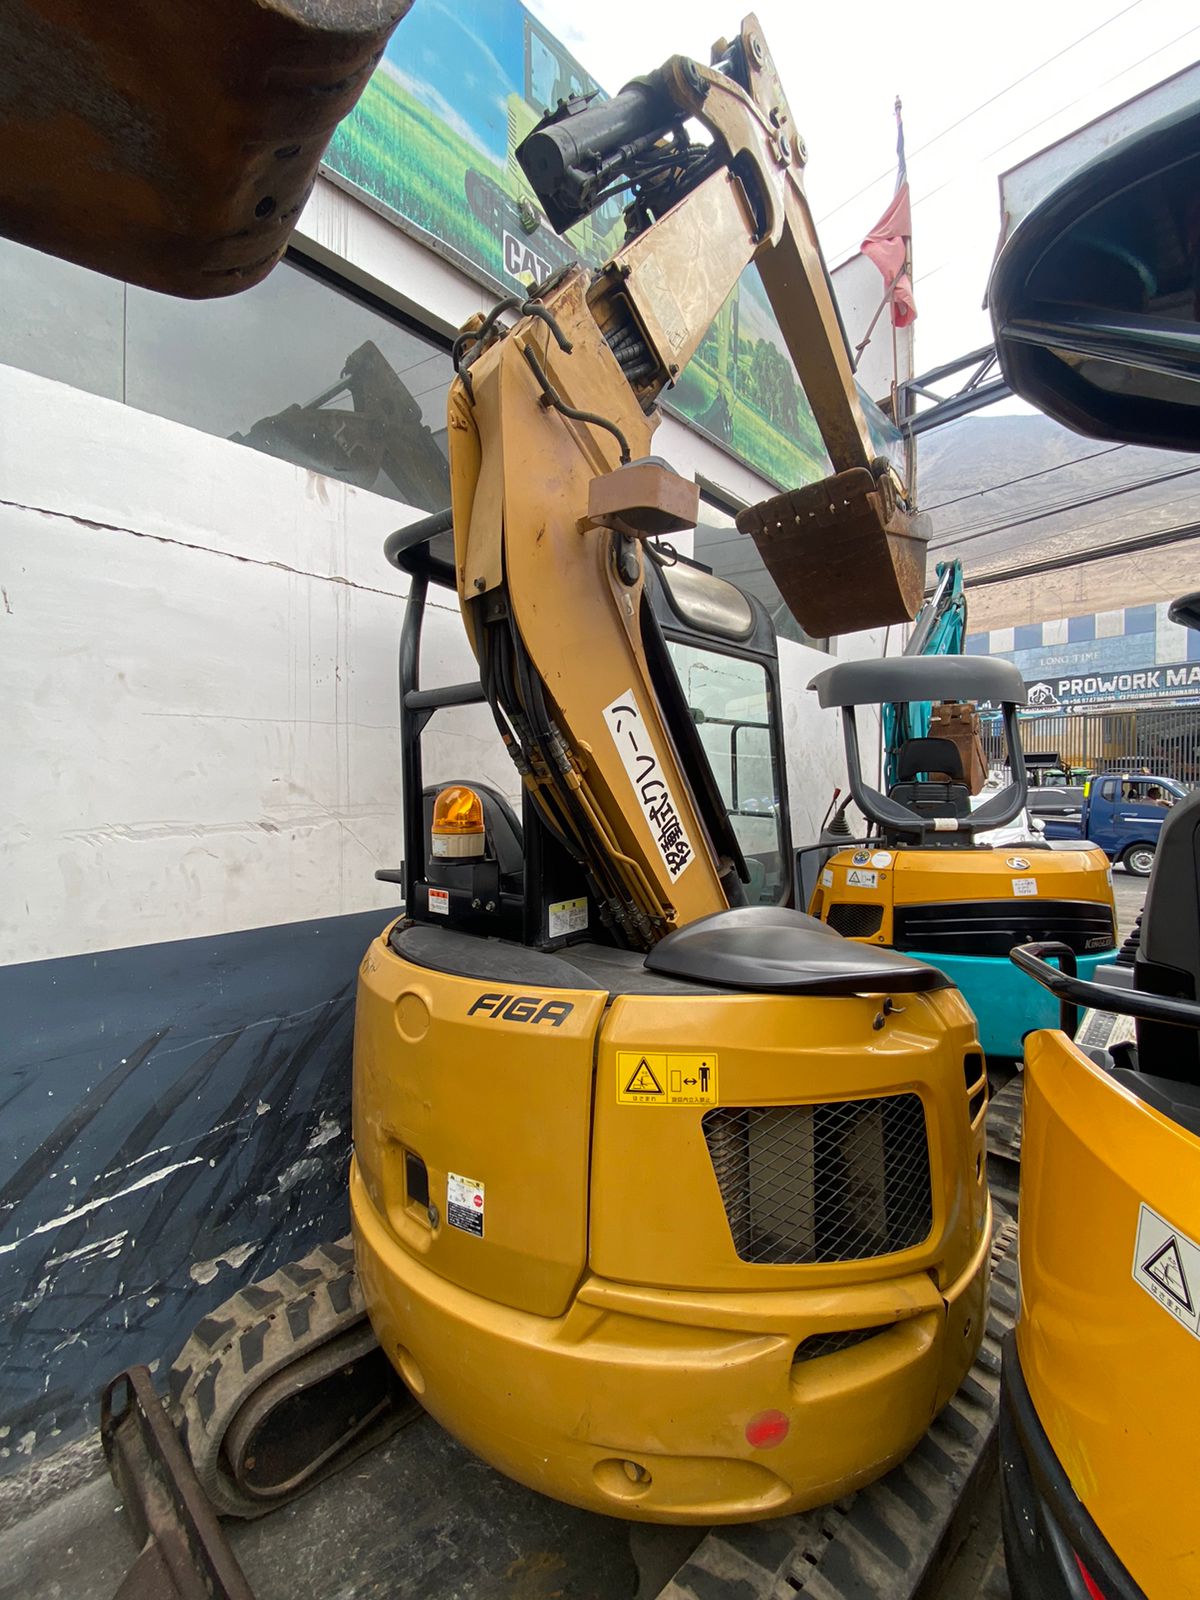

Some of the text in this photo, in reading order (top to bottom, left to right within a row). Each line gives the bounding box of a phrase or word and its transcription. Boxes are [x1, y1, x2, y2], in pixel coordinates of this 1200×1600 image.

[505, 234, 551, 286] CAT
[1040, 651, 1101, 666] LONG TIME
[1058, 670, 1161, 697] PROWORK
[611, 704, 692, 876] 移動式クレーン
[466, 993, 575, 1027] FIGA
[1150, 1282, 1183, 1317] はさまれ
